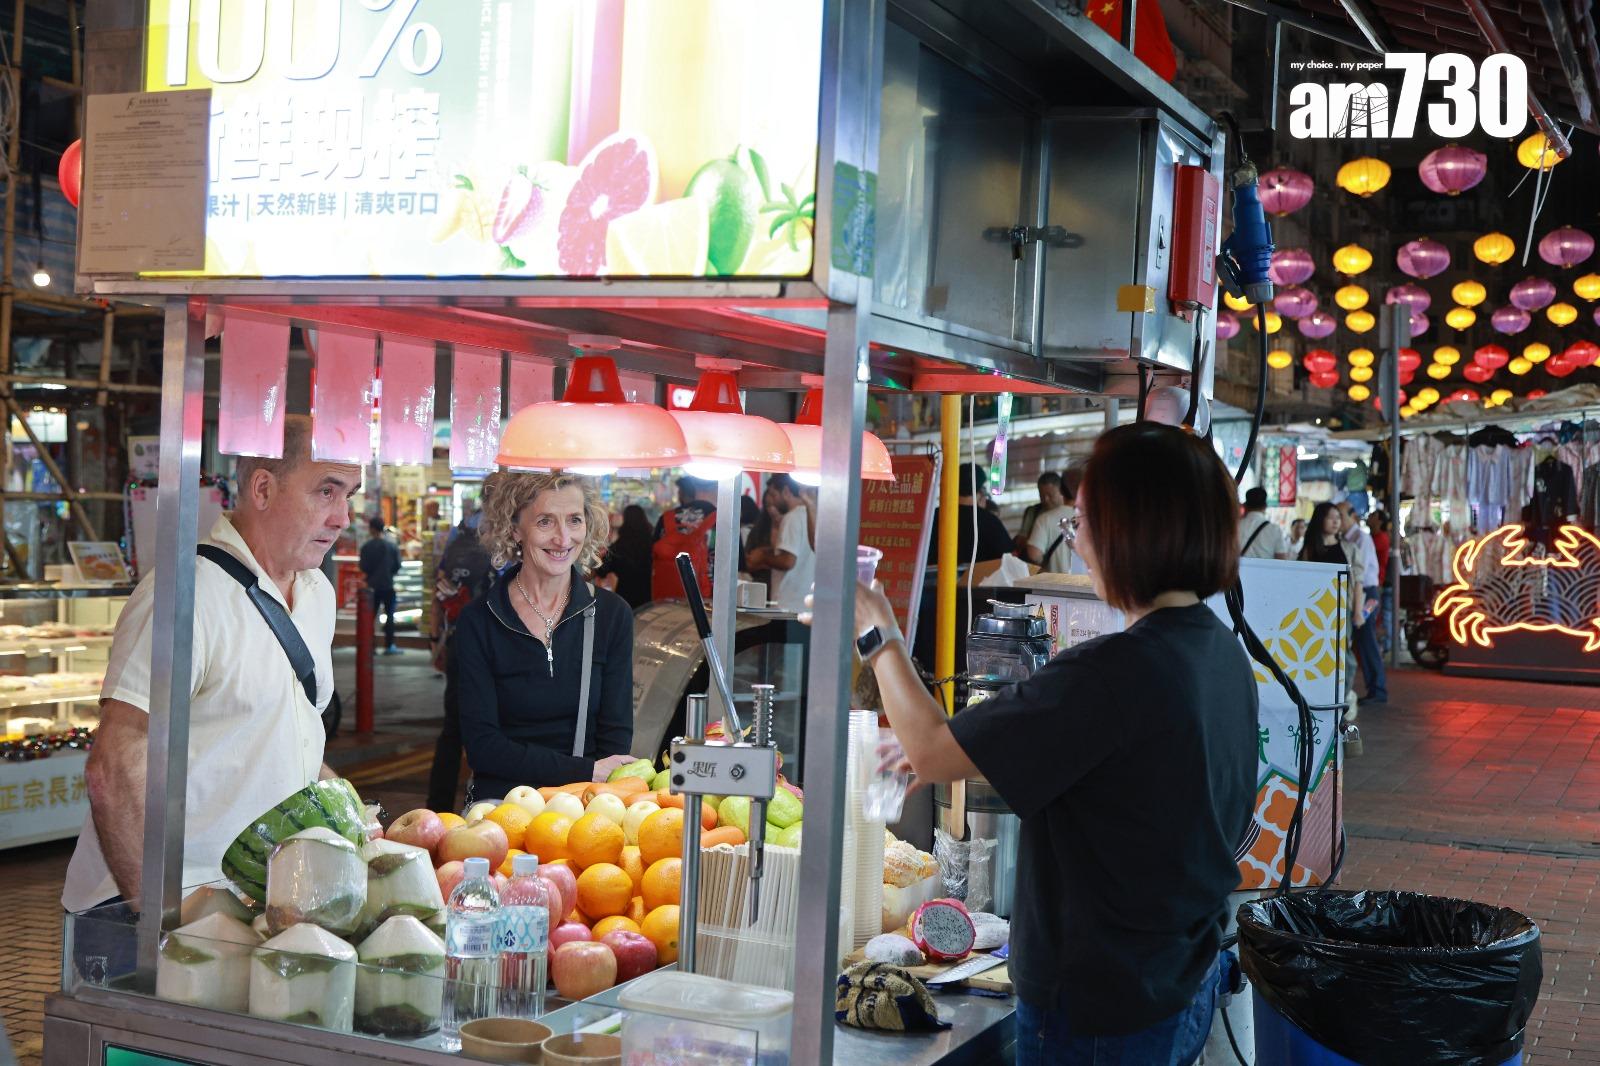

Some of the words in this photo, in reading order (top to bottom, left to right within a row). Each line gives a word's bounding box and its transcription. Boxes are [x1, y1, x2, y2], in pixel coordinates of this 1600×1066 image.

[167, 0, 444, 86] 100%
[479, 30, 492, 72] FRESH
[478, 75, 490, 89] IS
[208, 87, 441, 182] 鲜现榨
[256, 192, 337, 217] 天然新鲜
[354, 190, 439, 216] 清爽可口
